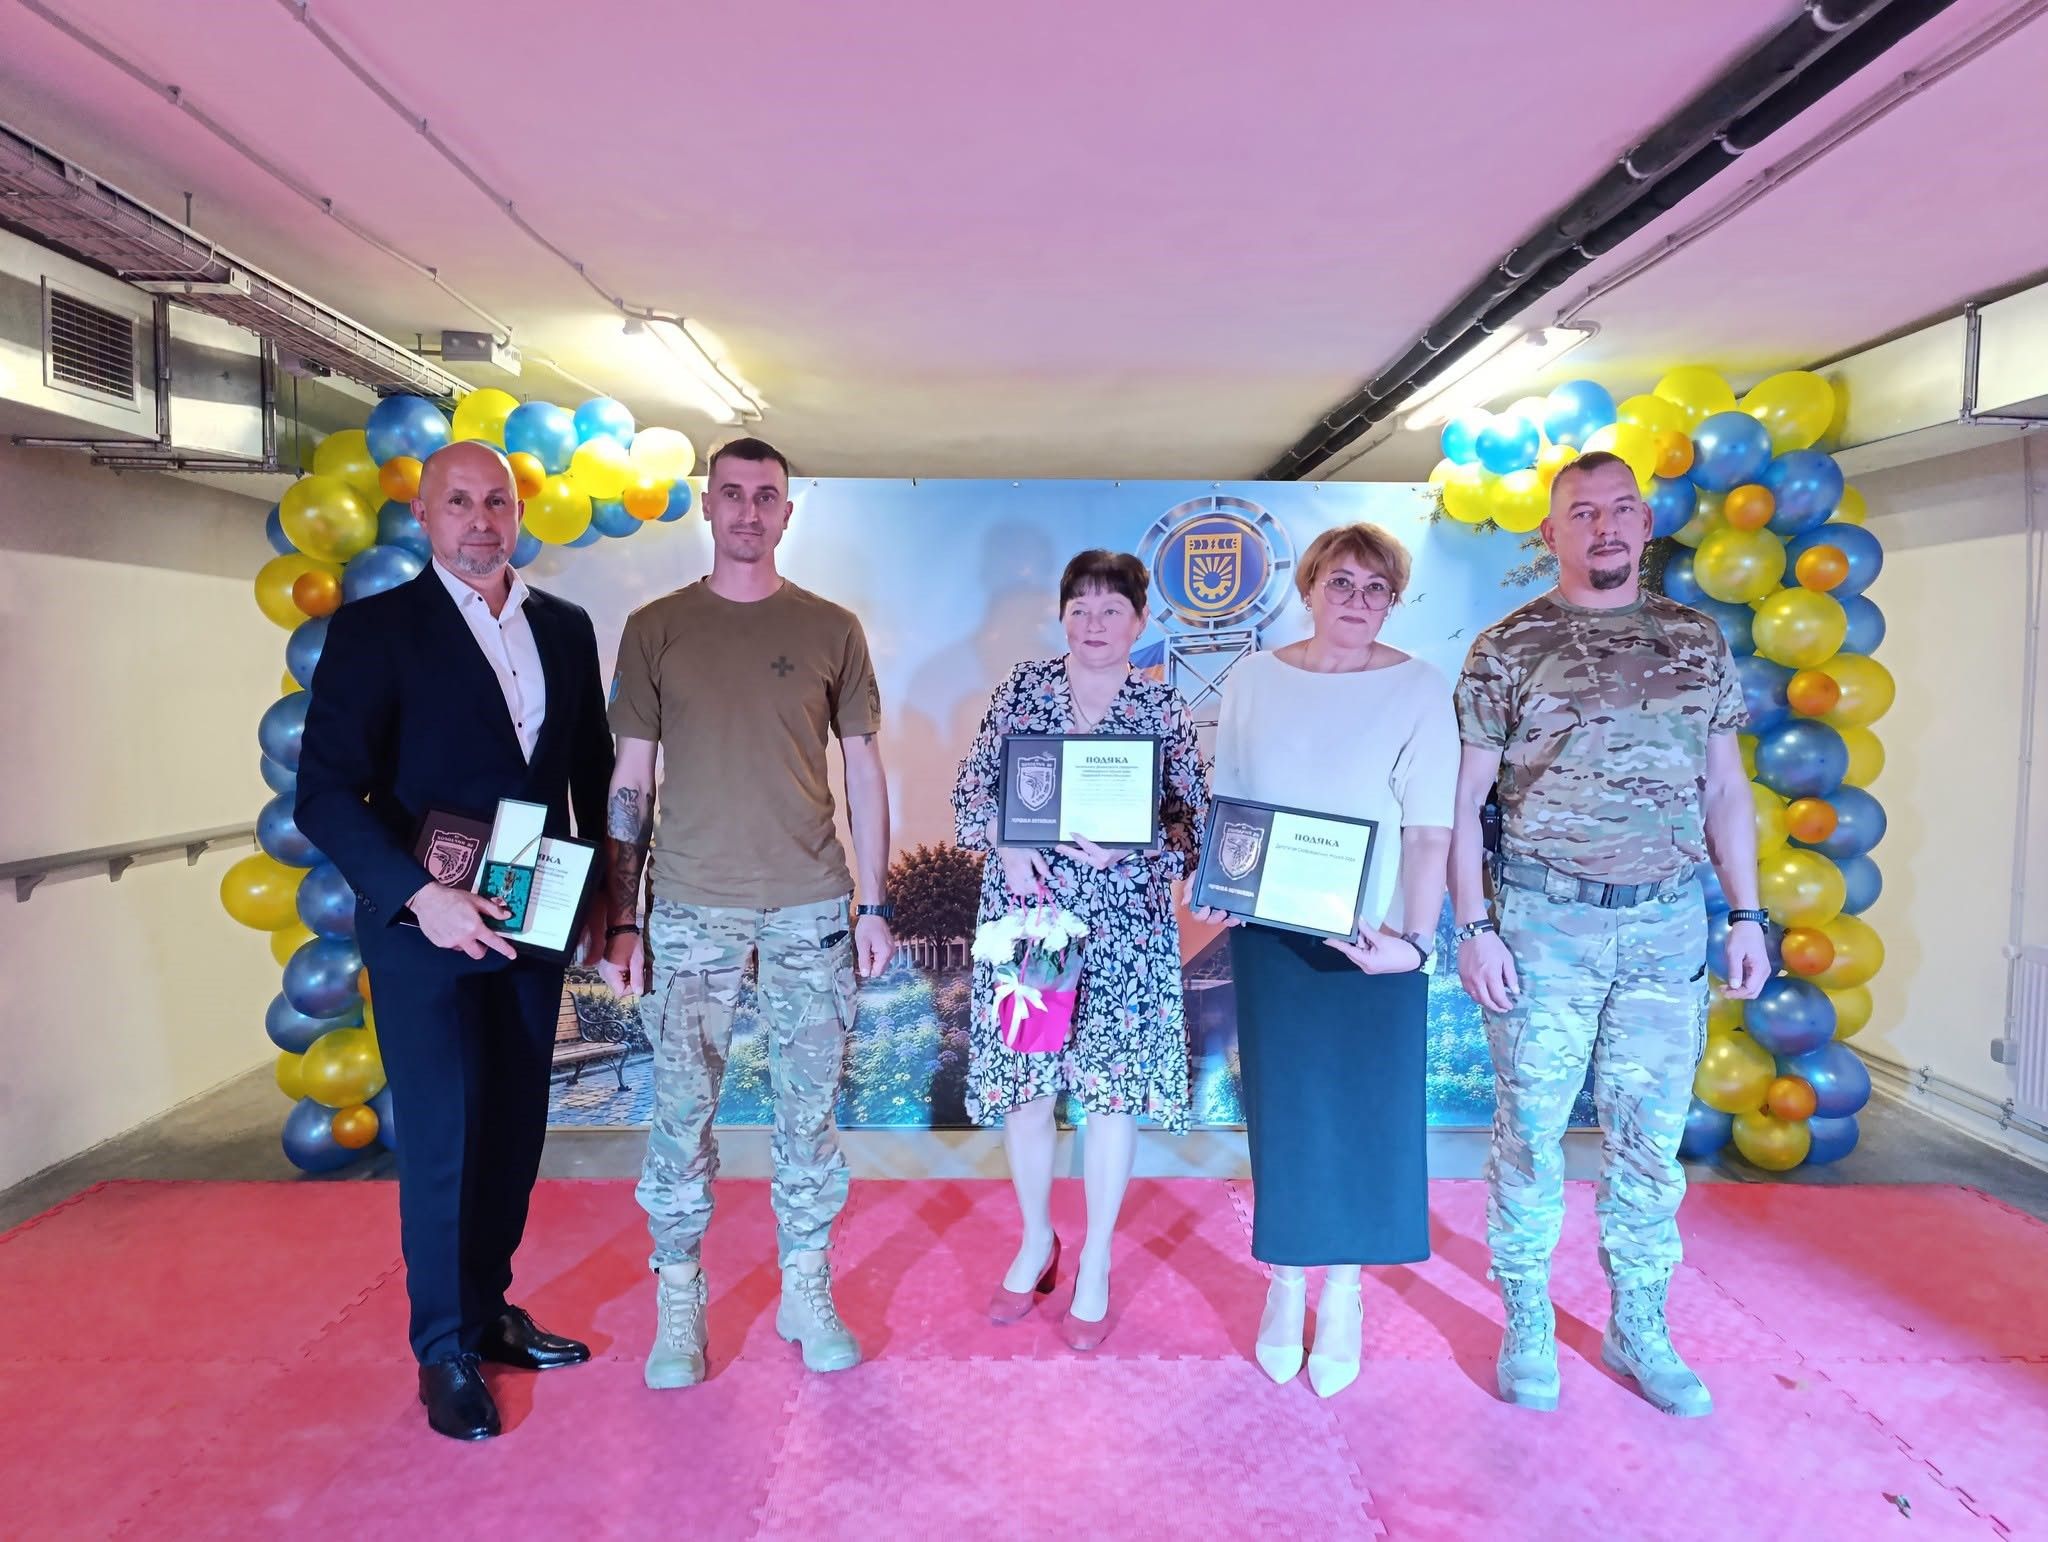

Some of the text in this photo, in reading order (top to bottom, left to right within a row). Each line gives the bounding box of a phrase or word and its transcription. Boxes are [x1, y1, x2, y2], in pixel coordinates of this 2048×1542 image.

[1086, 756, 1129, 764] ПОДЯКА
[1294, 833, 1340, 848] ПОДЯКА
[538, 853, 561, 865] ЯКА
